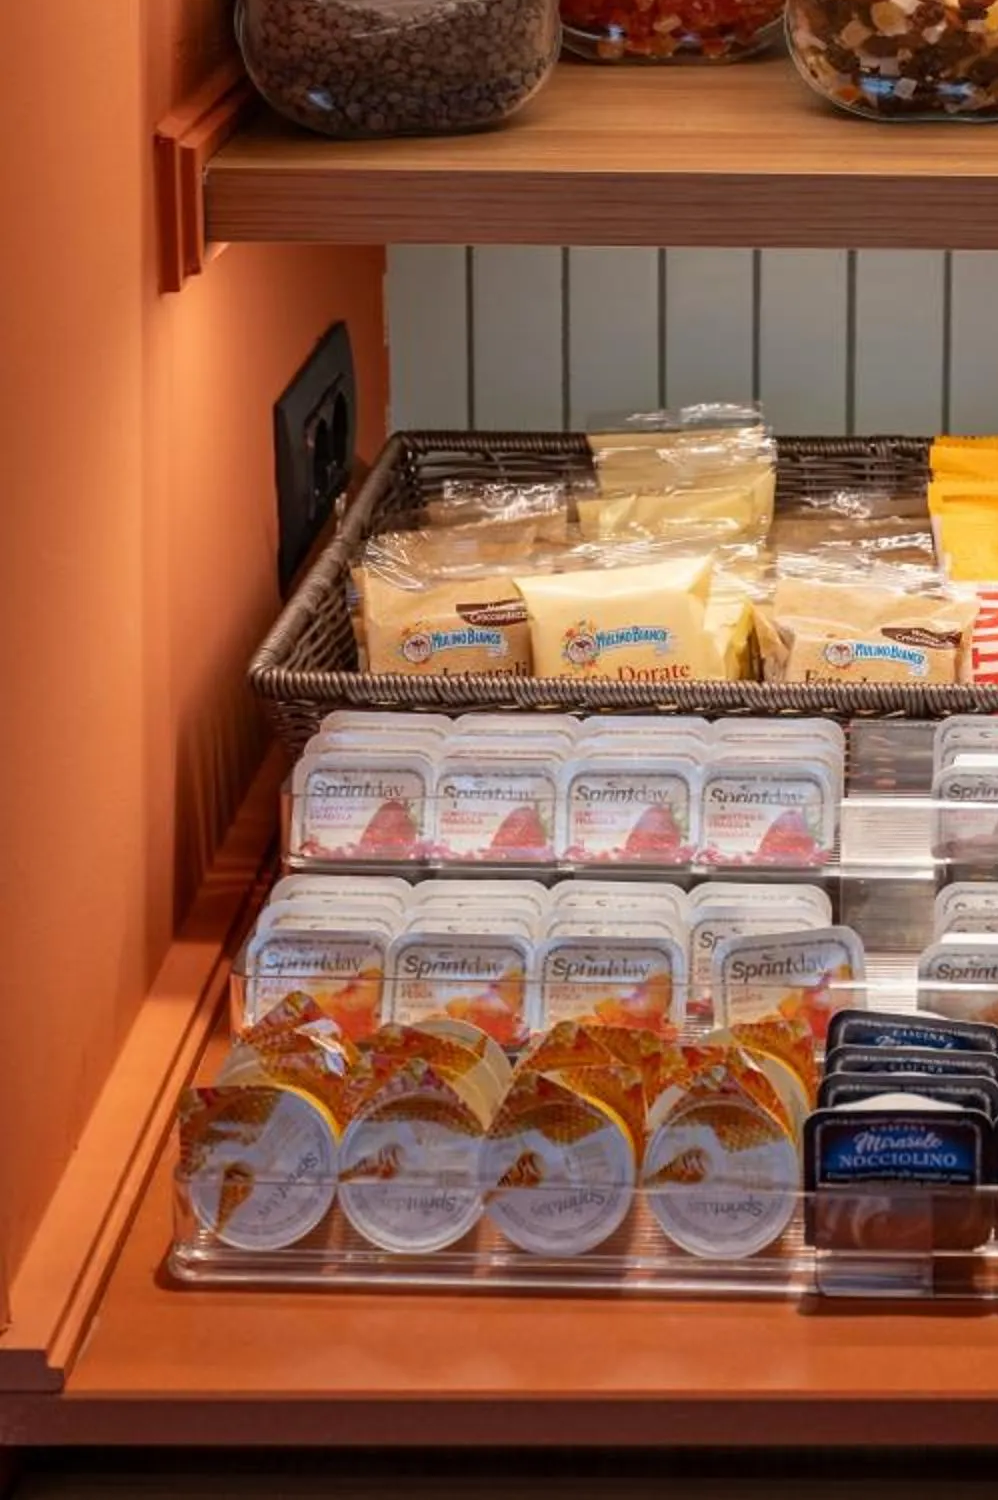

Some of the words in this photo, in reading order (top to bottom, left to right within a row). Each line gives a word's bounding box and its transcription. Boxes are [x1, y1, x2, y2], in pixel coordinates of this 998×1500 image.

[618, 663, 691, 682] Dorate
[853, 1129, 943, 1154] Mirasole
[839, 1153, 958, 1169] NOCCIOLINO
